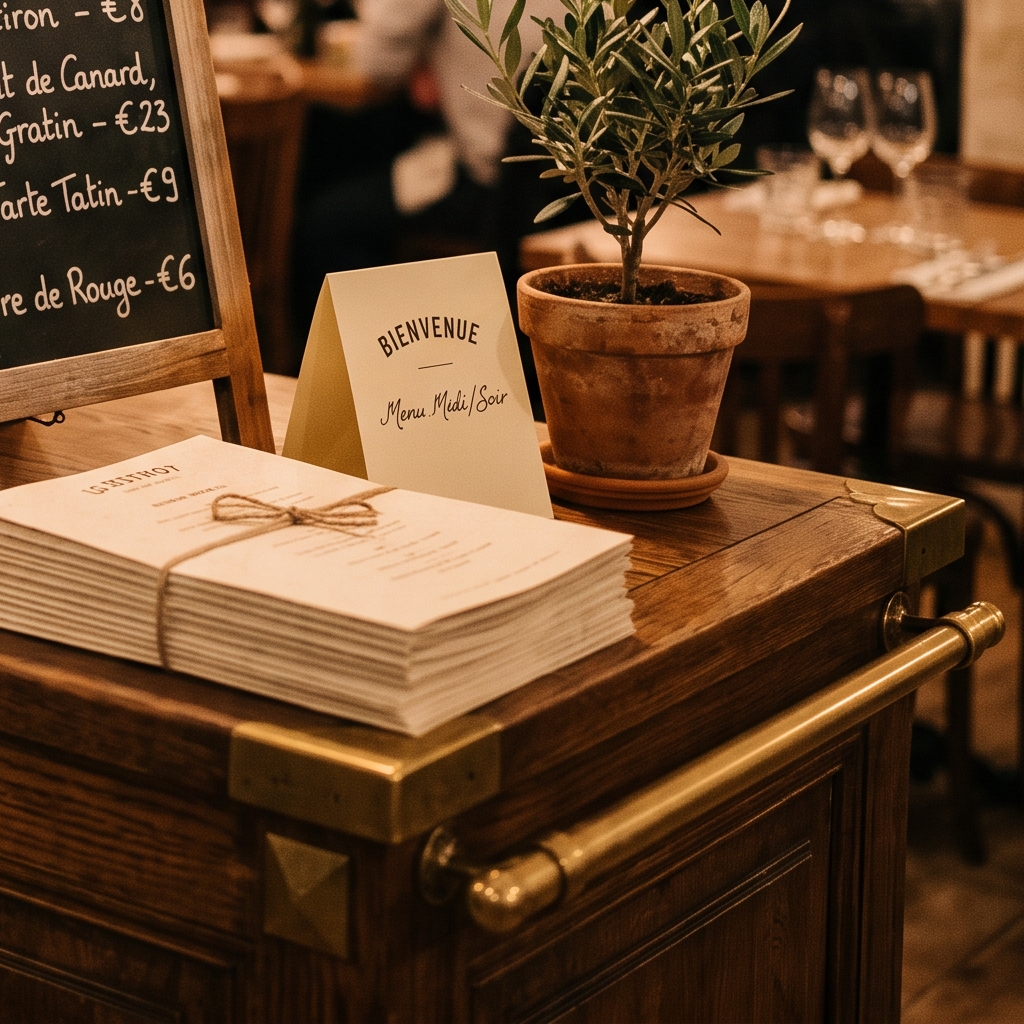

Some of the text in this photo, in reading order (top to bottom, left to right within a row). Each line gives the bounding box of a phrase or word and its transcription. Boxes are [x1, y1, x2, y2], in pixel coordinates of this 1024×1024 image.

[26, 61, 54, 95] de
[61, 52, 155, 91] Canard,
[115, 100, 169, 135] €23
[51, 173, 122, 212] Tatin
[35, 275, 63, 310] de
[67, 267, 141, 318] Rouge
[377, 316, 480, 358] BIENVENUE
[380, 398, 426, 430] Menu
